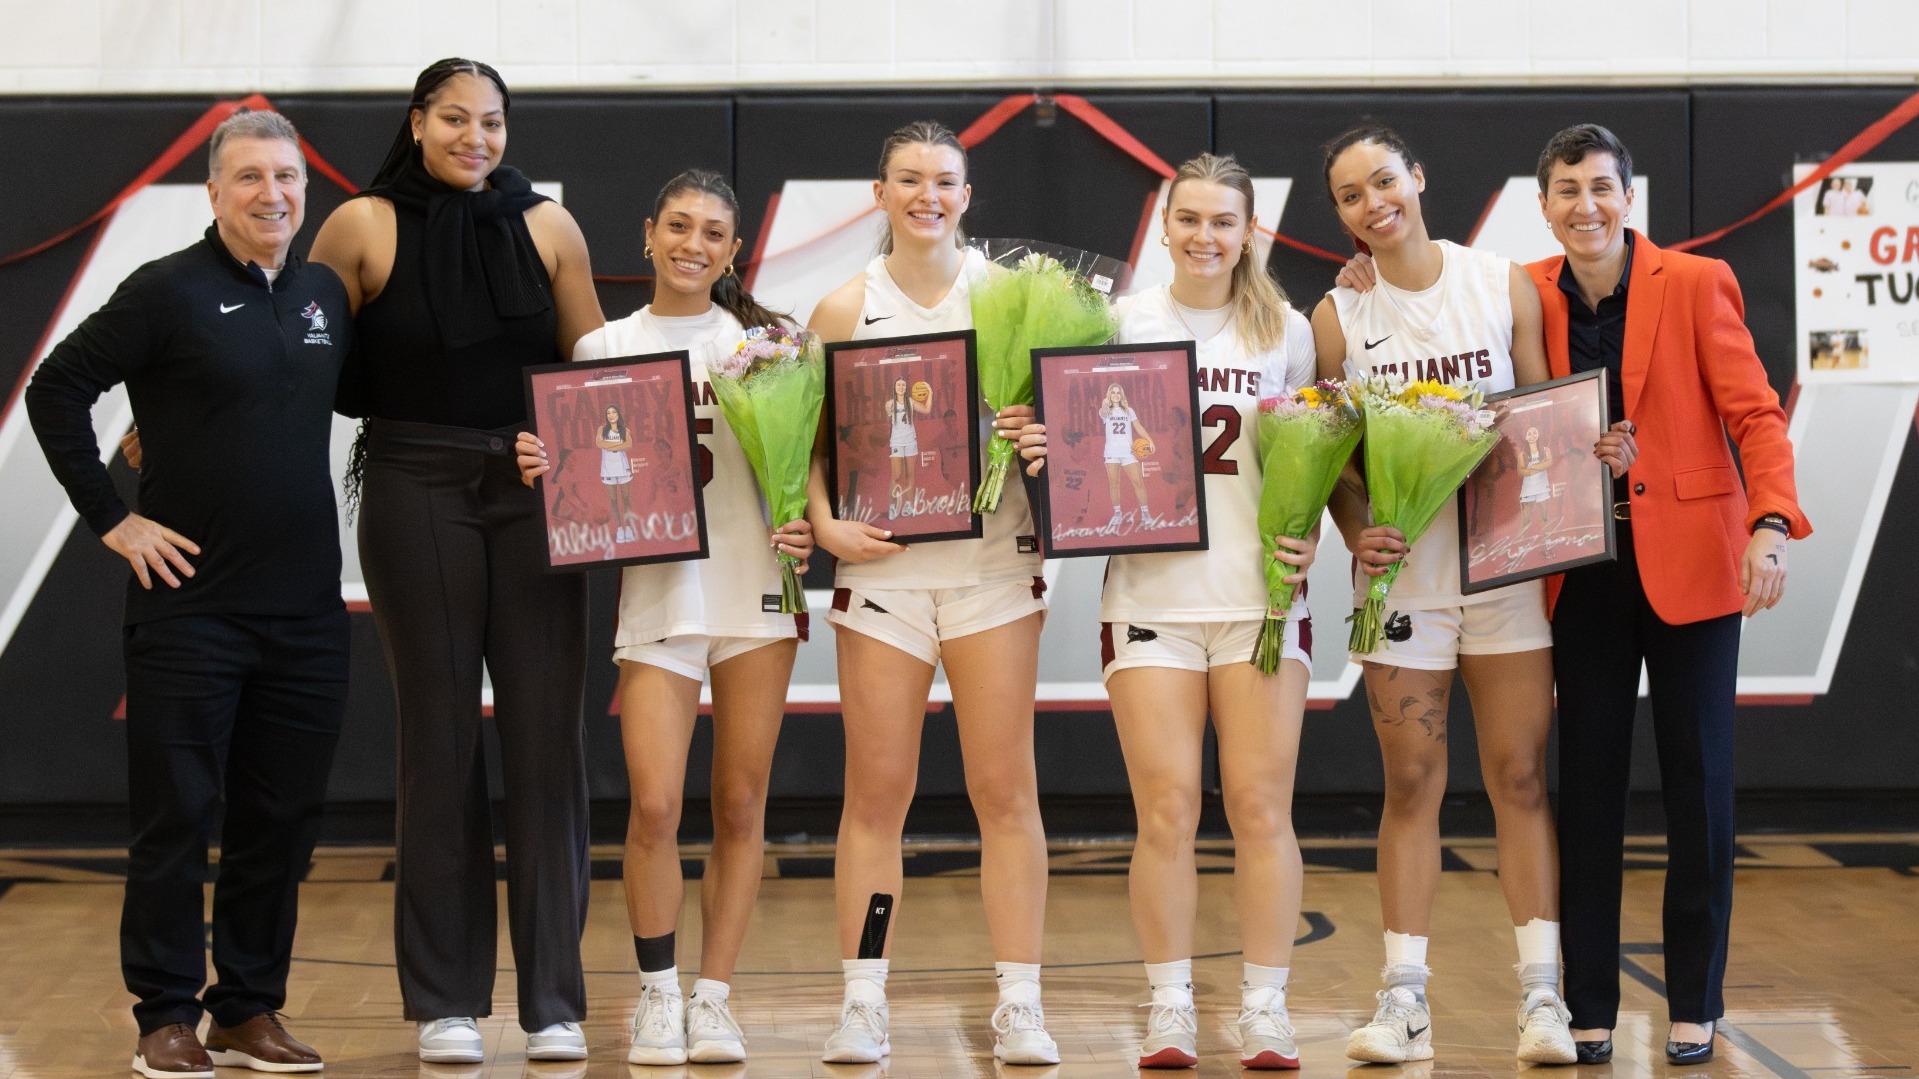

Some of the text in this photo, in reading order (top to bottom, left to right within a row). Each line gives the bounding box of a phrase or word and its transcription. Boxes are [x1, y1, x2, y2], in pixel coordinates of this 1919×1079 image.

[1855, 273, 1919, 306] TU
[1112, 422, 1126, 434] 22
[875, 907, 885, 915] KT
